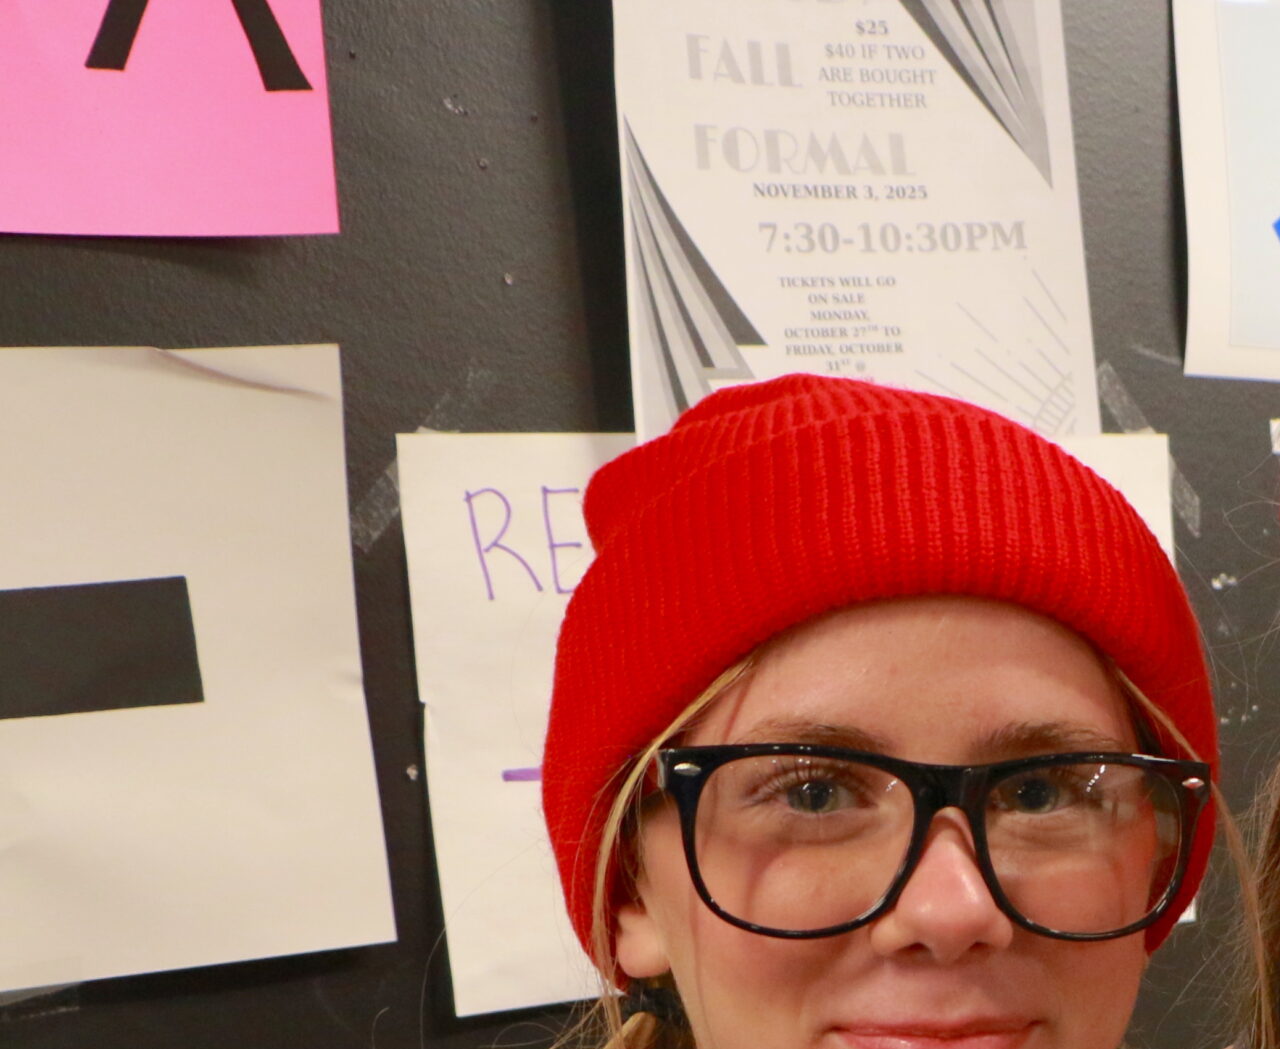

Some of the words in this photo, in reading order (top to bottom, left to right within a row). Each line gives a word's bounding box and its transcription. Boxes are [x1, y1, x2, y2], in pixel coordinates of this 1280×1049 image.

[855, 19, 888, 36] $25
[824, 43, 855, 60] $40
[861, 44, 878, 60] IF
[883, 44, 925, 60] TWO
[685, 33, 804, 88] FALL
[818, 66, 853, 83] ARE
[860, 67, 936, 85] BOUGHT
[827, 91, 927, 108] TOGETHER
[693, 123, 917, 176] FORMAL
[753, 183, 858, 200] NOVEMBER
[864, 186, 880, 202] 3,
[885, 185, 928, 200] 2025
[758, 220, 1027, 253] 7:30-10:30PM
[779, 276, 835, 288] TICKETS
[838, 276, 872, 288] WILL
[876, 275, 896, 287] GO
[808, 293, 828, 304] ON
[832, 292, 865, 304] SALE
[784, 326, 848, 338] OCTOBER
[883, 326, 902, 337] TO
[839, 342, 904, 353] OCTOBER
